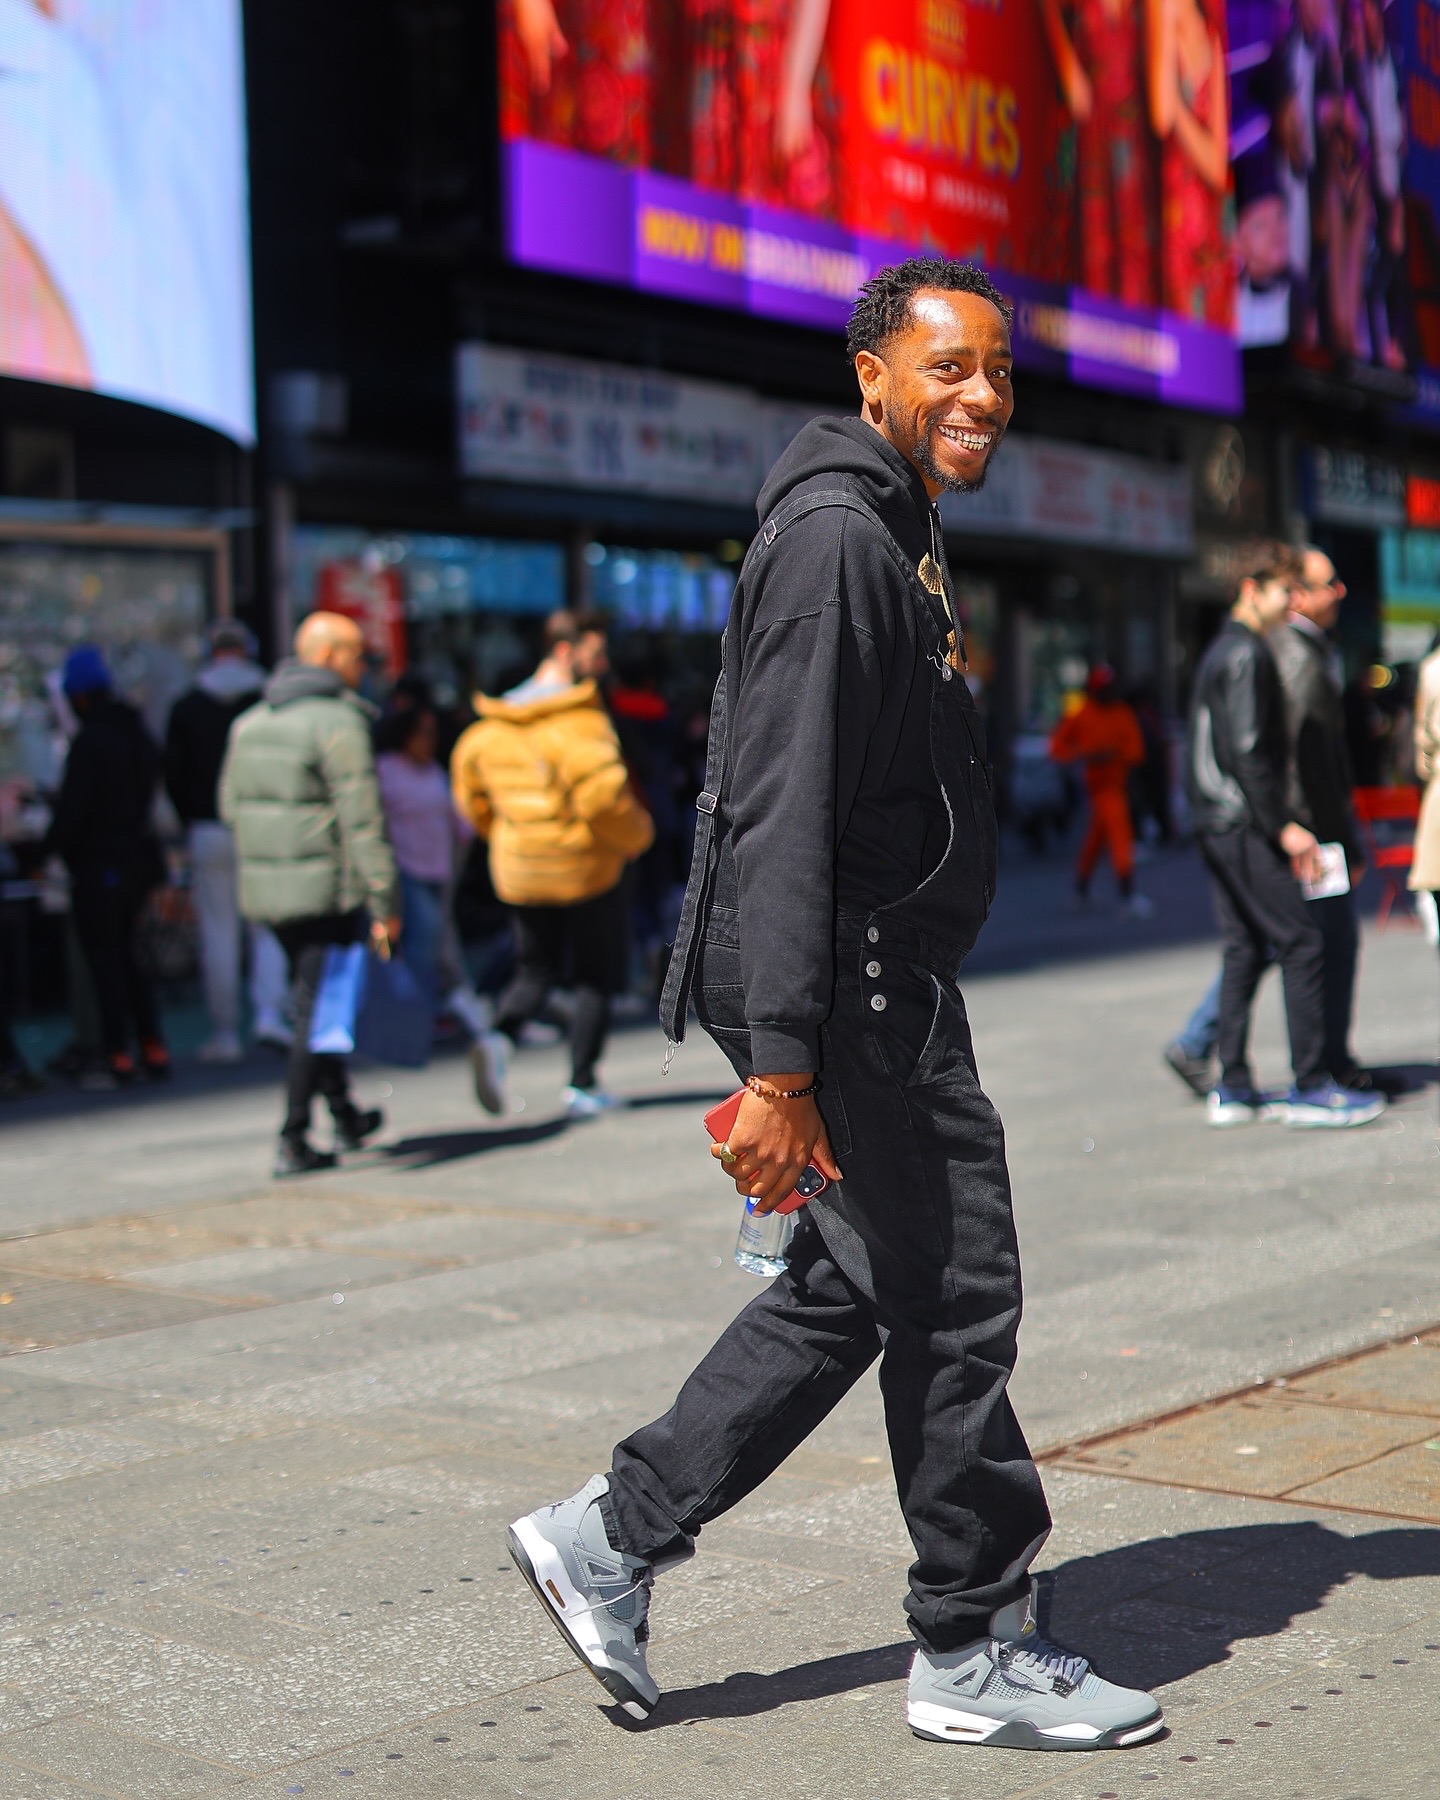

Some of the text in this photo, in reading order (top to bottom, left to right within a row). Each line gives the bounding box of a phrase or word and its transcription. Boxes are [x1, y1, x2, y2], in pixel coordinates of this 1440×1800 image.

[862, 38, 1020, 178] CURVES
[641, 205, 707, 265] NOW
[709, 219, 746, 274] ON
